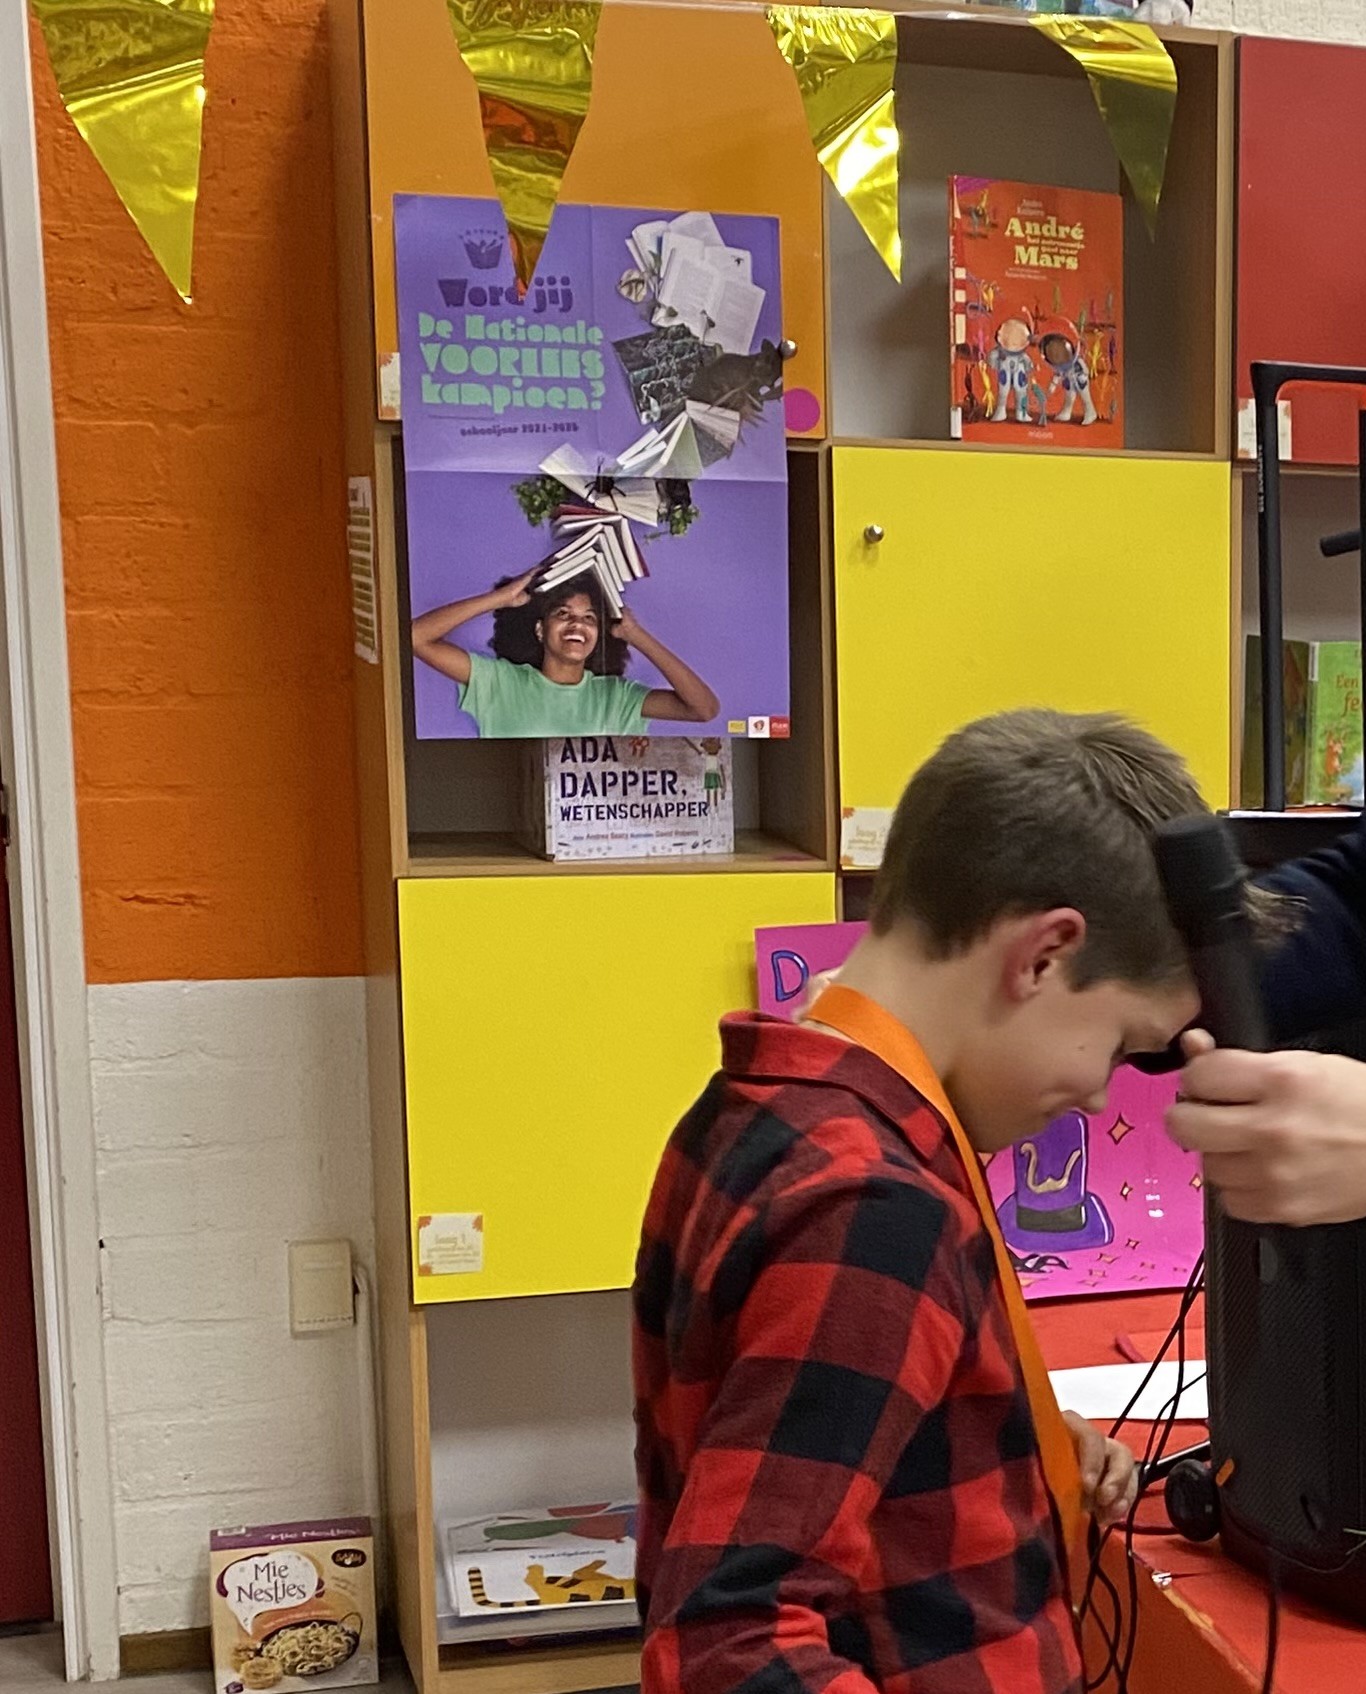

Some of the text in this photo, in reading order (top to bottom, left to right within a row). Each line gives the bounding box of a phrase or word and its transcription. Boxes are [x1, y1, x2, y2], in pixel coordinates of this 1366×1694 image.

[1004, 215, 1084, 240] André
[1014, 245, 1079, 270] Mars
[533, 276, 573, 313] jij
[418, 312, 604, 345] De Nationale
[419, 343, 605, 379] VOORLEES
[421, 373, 606, 414] kampioen?
[560, 736, 619, 763] ADA
[560, 770, 687, 798] DAPPER,
[560, 801, 710, 822] WETENSCHAPPER
[771, 950, 810, 1002] D
[254, 1560, 289, 1583] Mie
[237, 1579, 307, 1604] Nestjes
